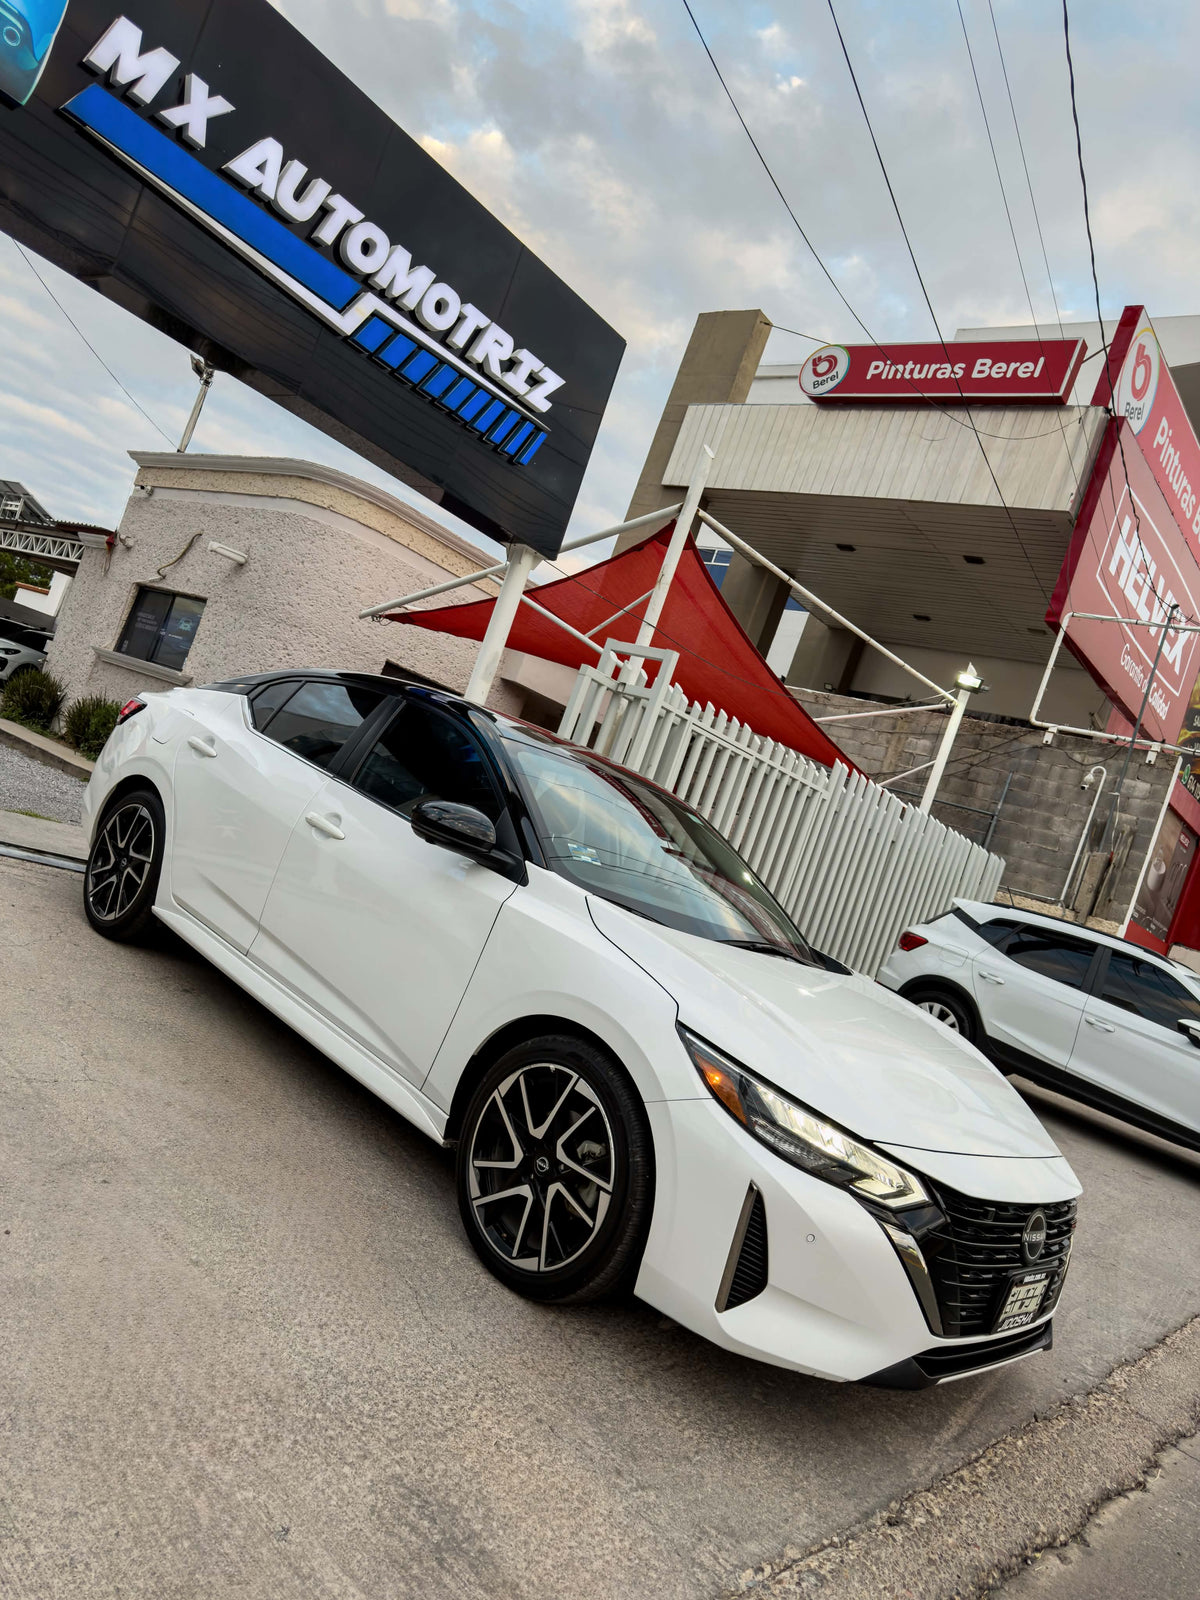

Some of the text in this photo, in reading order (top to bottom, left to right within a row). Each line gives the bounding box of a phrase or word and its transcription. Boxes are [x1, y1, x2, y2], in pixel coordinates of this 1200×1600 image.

[82, 15, 566, 413] MX AUTOMOTRIZ
[813, 371, 839, 389] Berel
[866, 356, 1045, 379] Pinturas Berel
[1124, 402, 1144, 421] Berel
[1153, 416, 1196, 519] Pinturas
[1108, 514, 1190, 676] HELVEX
[1148, 682, 1171, 720] Calidad
